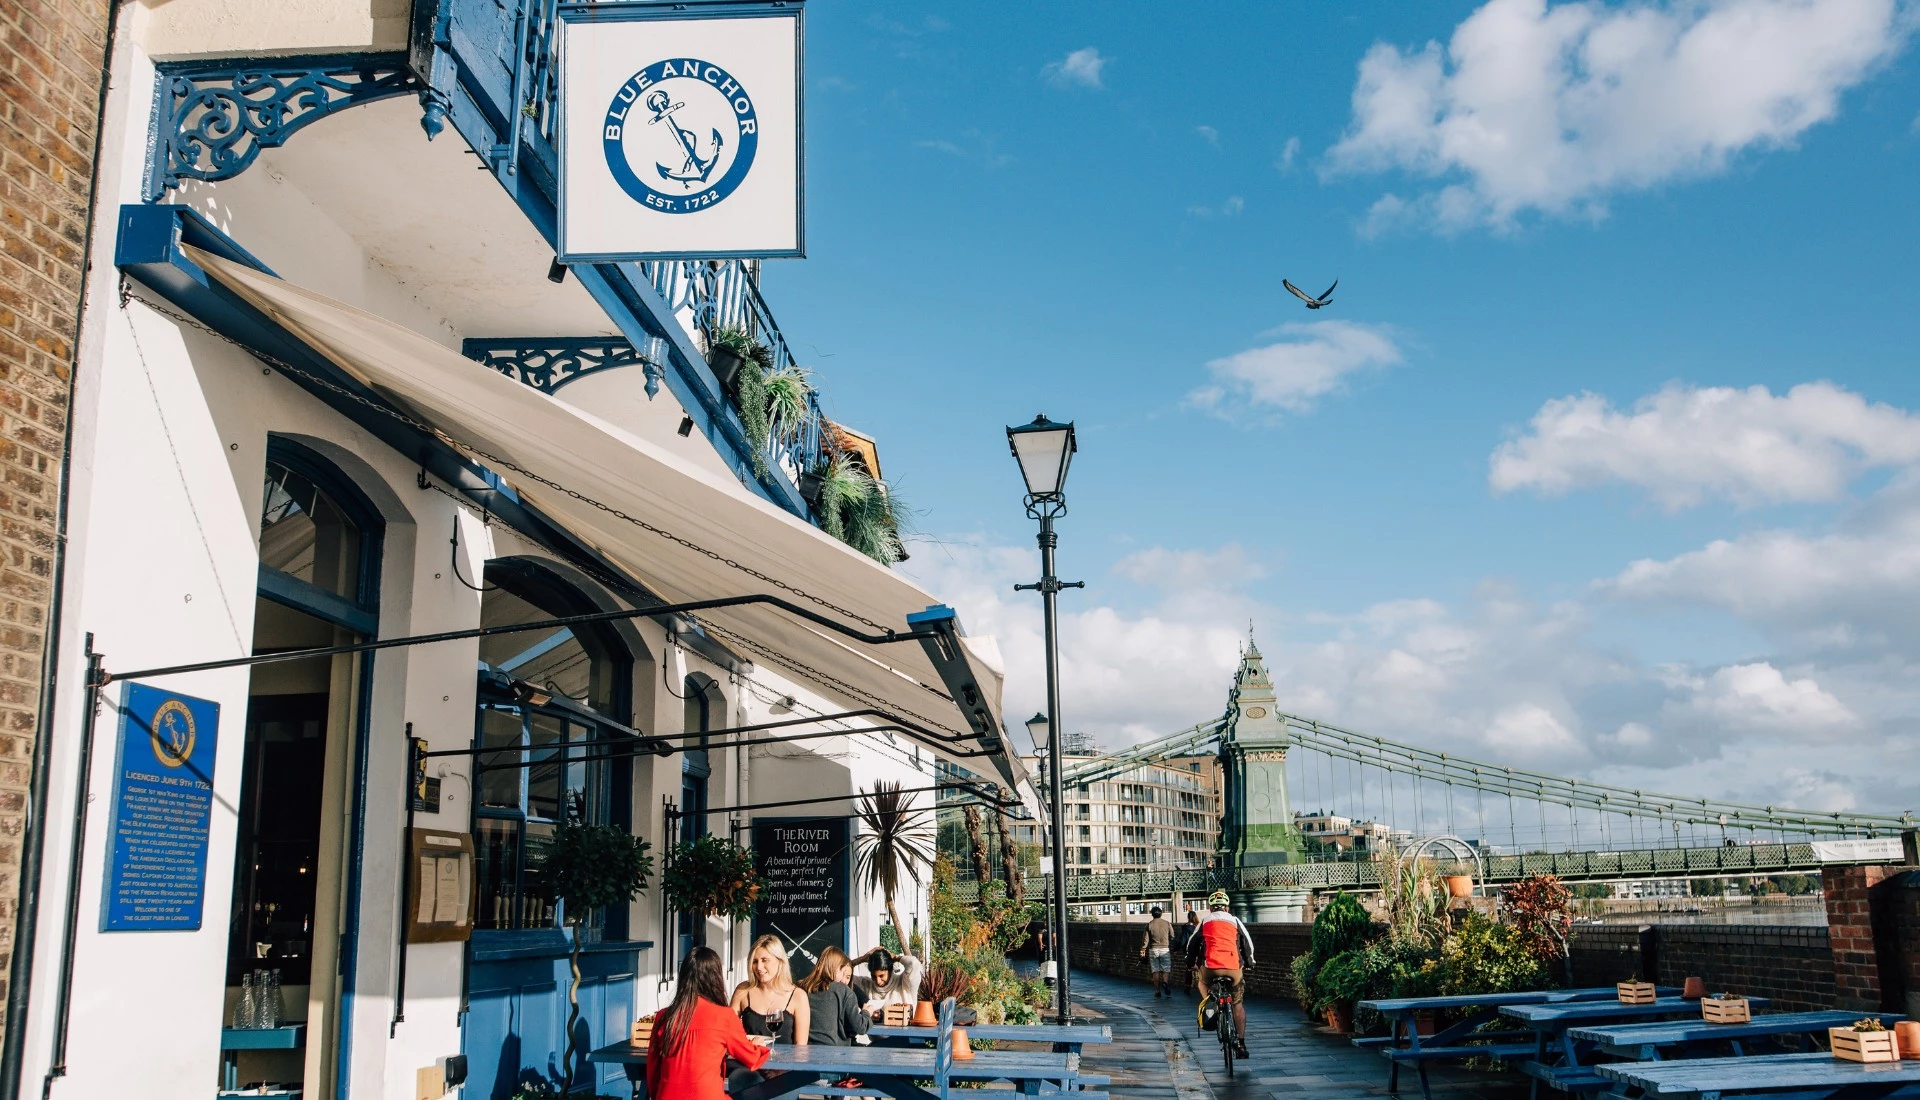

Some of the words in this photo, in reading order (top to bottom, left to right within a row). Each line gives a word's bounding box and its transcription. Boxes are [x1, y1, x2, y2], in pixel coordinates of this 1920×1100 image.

[605, 70, 654, 141] BLUE
[662, 60, 756, 136] ANCHOR
[645, 193, 677, 210] EST.
[685, 190, 719, 210] 1722
[153, 704, 168, 730] BLUE
[172, 702, 194, 737] ANCHOR
[126, 771, 160, 782] LICENCED
[161, 777, 178, 785] JUNE
[195, 781, 209, 790] 1722
[774, 828, 796, 840] THE
[798, 828, 829, 840] RIVER
[784, 842, 819, 853] ROOM
[765, 857, 773, 866] A
[774, 856, 806, 866] beautiful
[807, 857, 832, 868] private
[791, 867, 814, 877] perfect
[816, 867, 826, 878] for
[797, 878, 824, 887] dinners
[827, 878, 834, 888] &
[768, 892, 786, 905] jolly
[789, 891, 806, 905] good
[766, 906, 778, 914] Ask
[781, 906, 797, 914] inside
[798, 906, 807, 914] for
